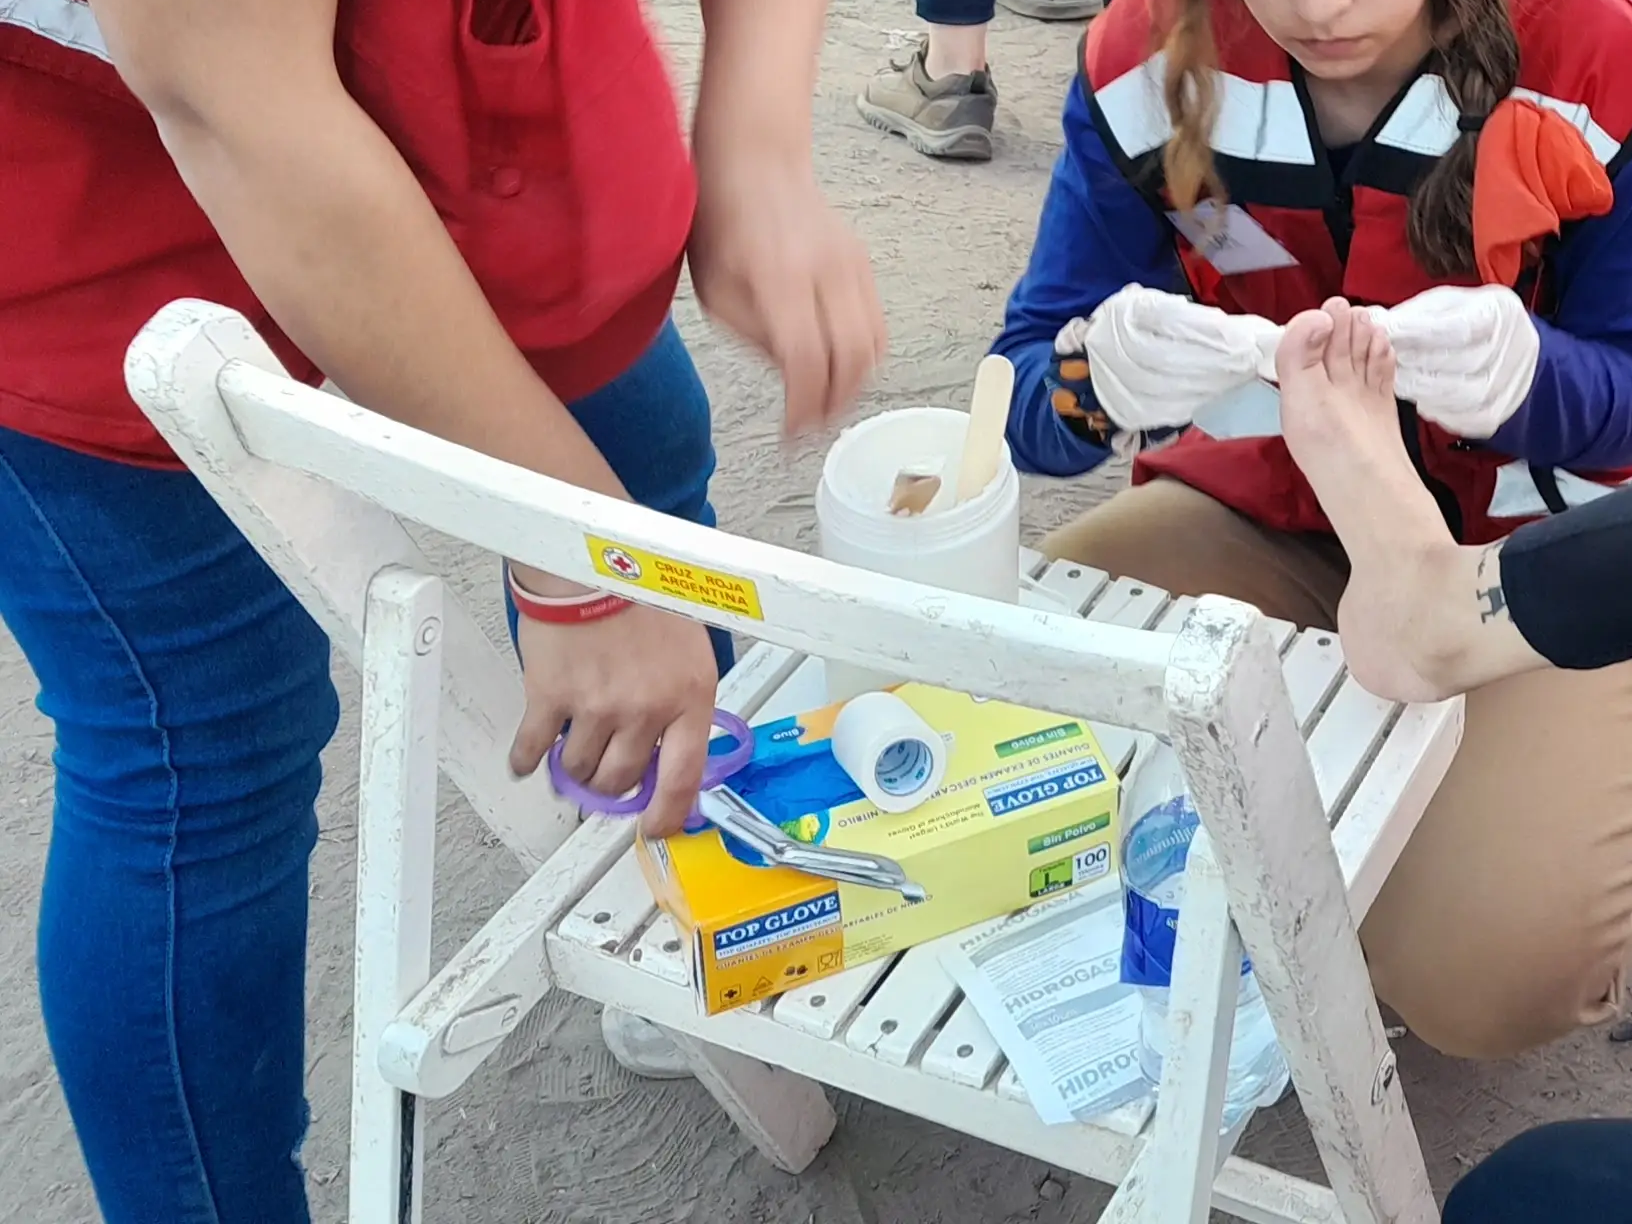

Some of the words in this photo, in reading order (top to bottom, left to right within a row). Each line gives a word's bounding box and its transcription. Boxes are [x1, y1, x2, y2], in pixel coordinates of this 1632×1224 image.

[654, 560, 697, 581] CRUZ
[704, 575, 745, 594] ROJA
[659, 574, 749, 608] ARGENTINA
[772, 727, 800, 741] Blue
[1011, 734, 1044, 751] Polvo
[1044, 727, 1067, 741] Sin
[1027, 755, 1042, 768] DE
[1047, 742, 1091, 763] GUANTES
[979, 761, 1025, 782] EXAMEN
[1064, 767, 1103, 790] TOP
[990, 782, 1060, 813] GLOVE
[838, 810, 879, 828] NITRILO
[1043, 834, 1062, 847] Sin
[1064, 822, 1097, 840] Polvo
[1076, 848, 1107, 870] 100
[716, 923, 760, 946] TOP
[765, 895, 838, 931] GLOVE
[716, 954, 760, 972] GUANTES
[777, 935, 816, 953] EXAMEN
[887, 905, 898, 916] DE
[1003, 957, 1118, 1014] HIDROGAS
